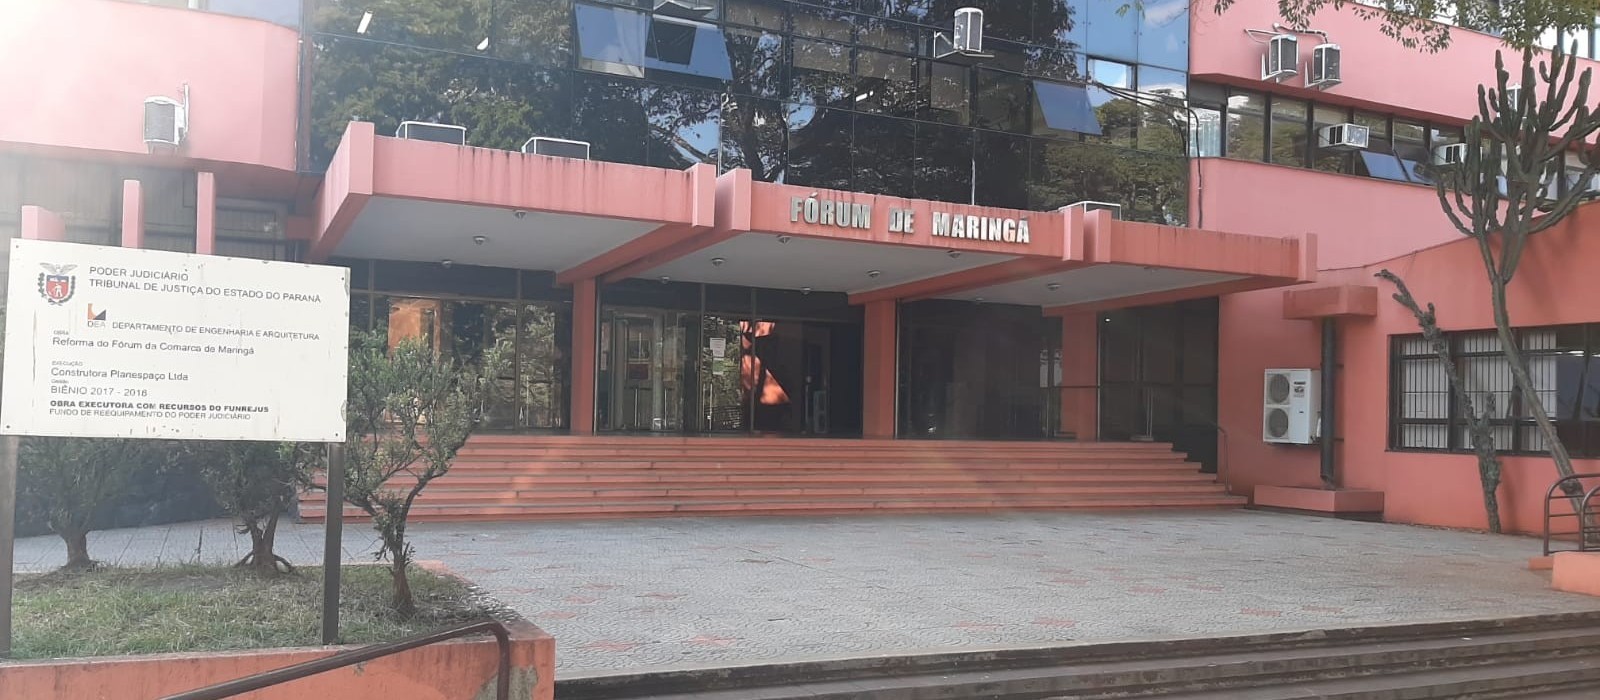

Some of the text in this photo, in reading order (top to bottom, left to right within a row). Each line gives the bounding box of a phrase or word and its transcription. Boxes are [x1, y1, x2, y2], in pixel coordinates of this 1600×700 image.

[790, 192, 1031, 243] FÓRUM DE MARINGÁ
[89, 266, 189, 281] PODER JUDICIÁRIO
[89, 278, 322, 303] TRIBUNAL DE JUSTIÇA DO ESTADO DO PARANÁ
[87, 320, 320, 341] DEA DEPARTAMENTO DE ENGENHARIA E ARQUITETURA
[52, 336, 255, 356] Reforma do Fórum da Comarca de Maringá
[50, 367, 189, 381] Construtora Planespaço Ltda
[50, 384, 88, 395] BIÊNIO
[90, 387, 114, 396] 2017
[49, 408, 79, 416] FUNDO
[93, 410, 164, 418] REEQUIPAMENTO
[207, 412, 251, 420] JUDICIÁRIO
[50, 400, 269, 413] OBRA EXECUTORA COM RECURSOS DO FUNREJUS
